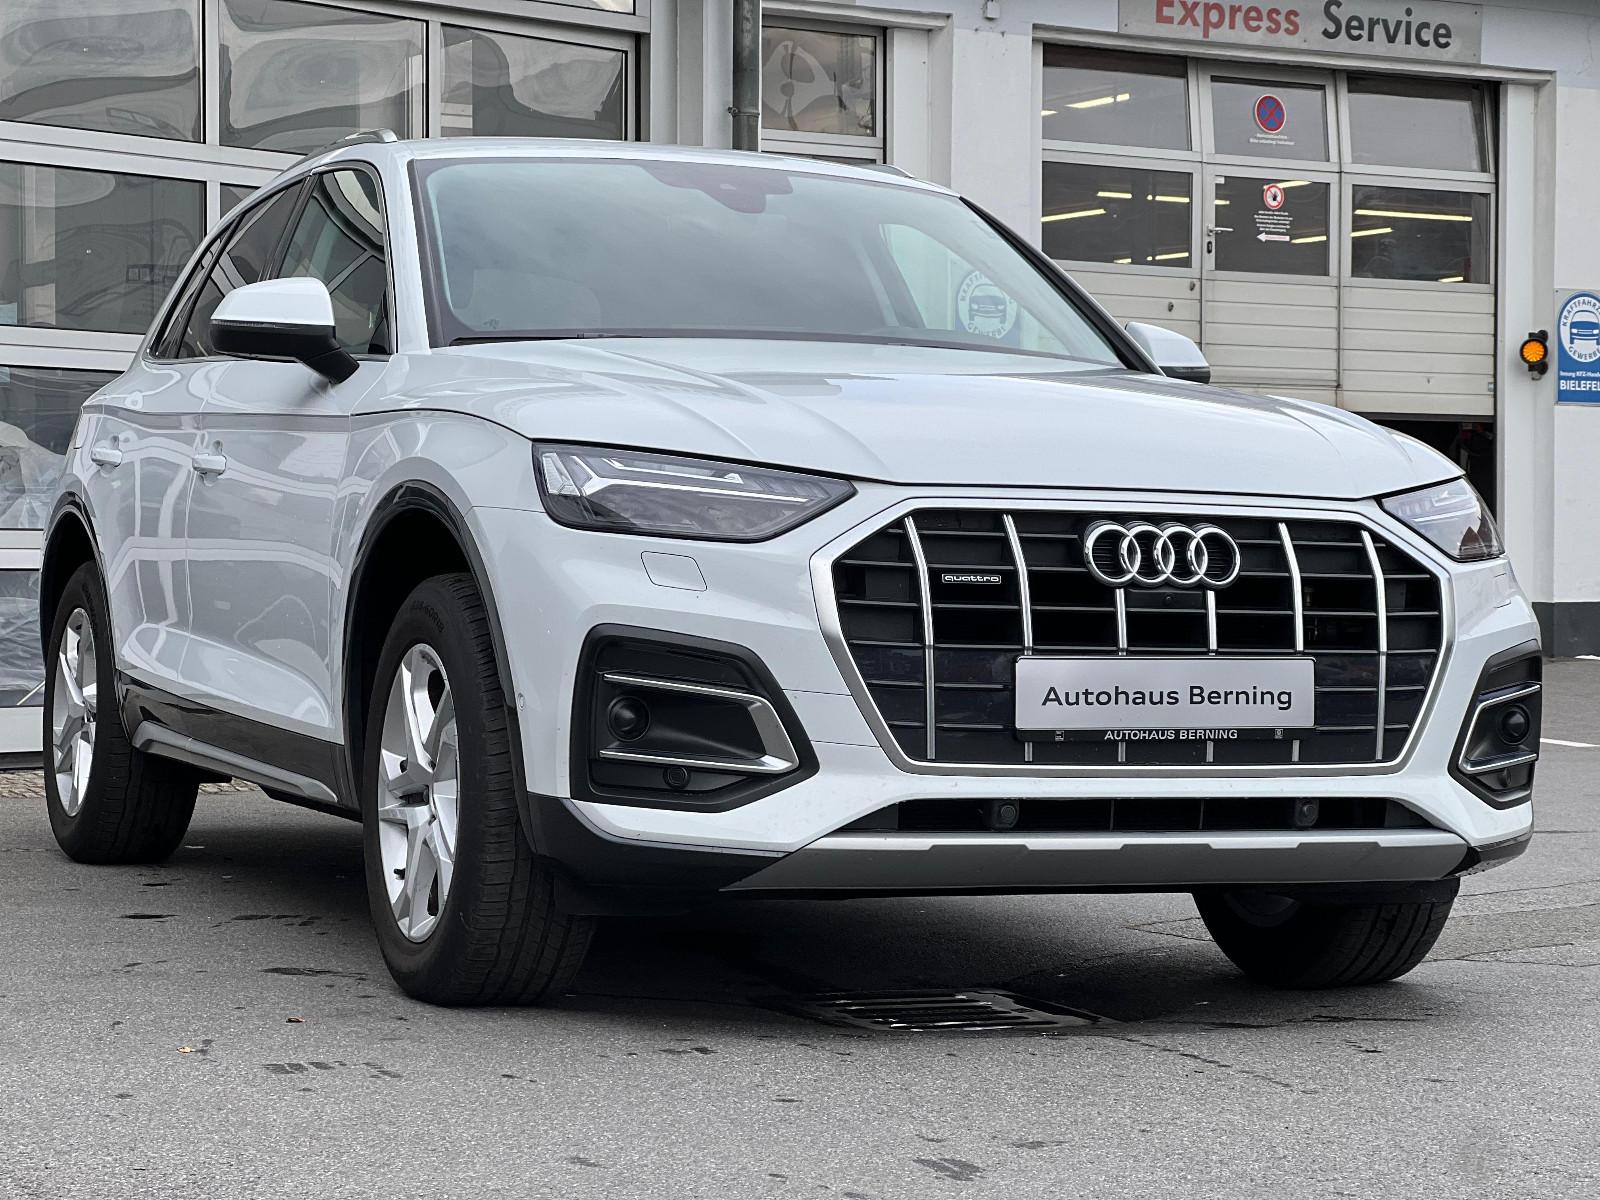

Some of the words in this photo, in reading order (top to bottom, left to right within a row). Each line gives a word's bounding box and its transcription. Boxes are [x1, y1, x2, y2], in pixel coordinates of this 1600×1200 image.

[1155, 0, 1301, 39] Express
[1321, 0, 1453, 49] Service
[1562, 299, 1600, 327] KRAFTFAHRZ
[1041, 686, 1180, 706] Autohaus
[1188, 685, 1292, 711] Berning
[1104, 730, 1176, 740] AUTOHAUS
[1179, 729, 1238, 740] BERNING
